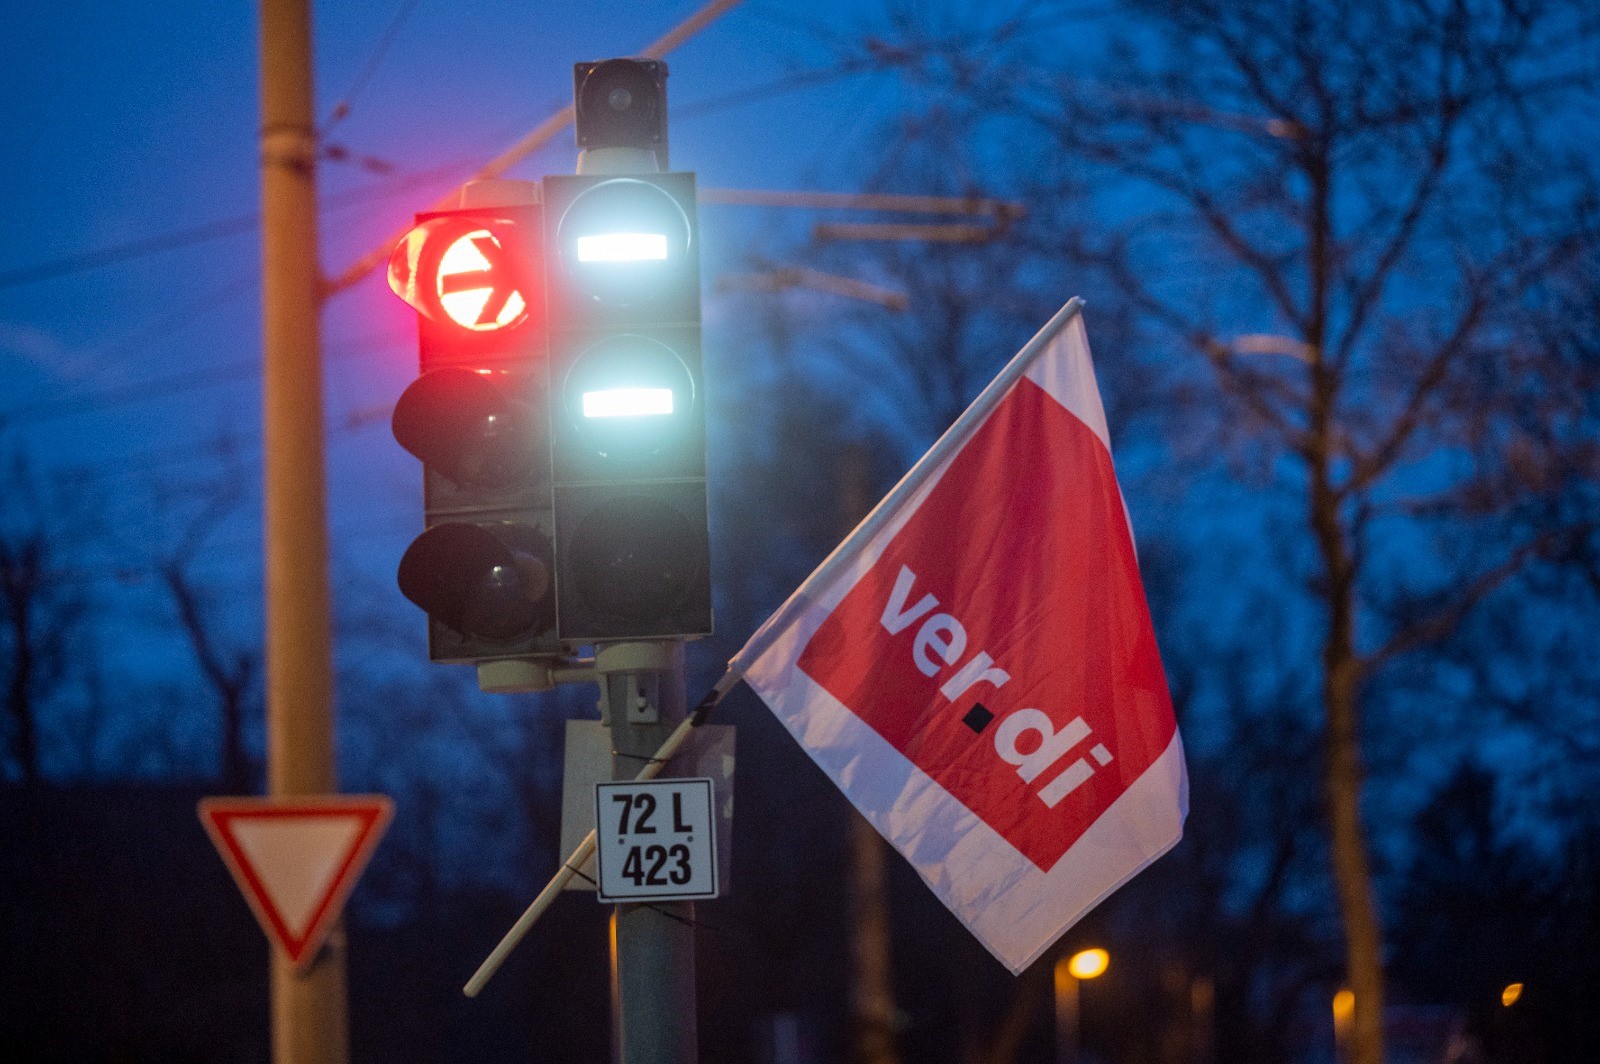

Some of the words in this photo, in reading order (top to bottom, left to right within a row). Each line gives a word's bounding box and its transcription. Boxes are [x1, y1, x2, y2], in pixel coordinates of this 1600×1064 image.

[612, 793, 657, 835] 72
[672, 792, 693, 833] L
[621, 843, 692, 887] 423
